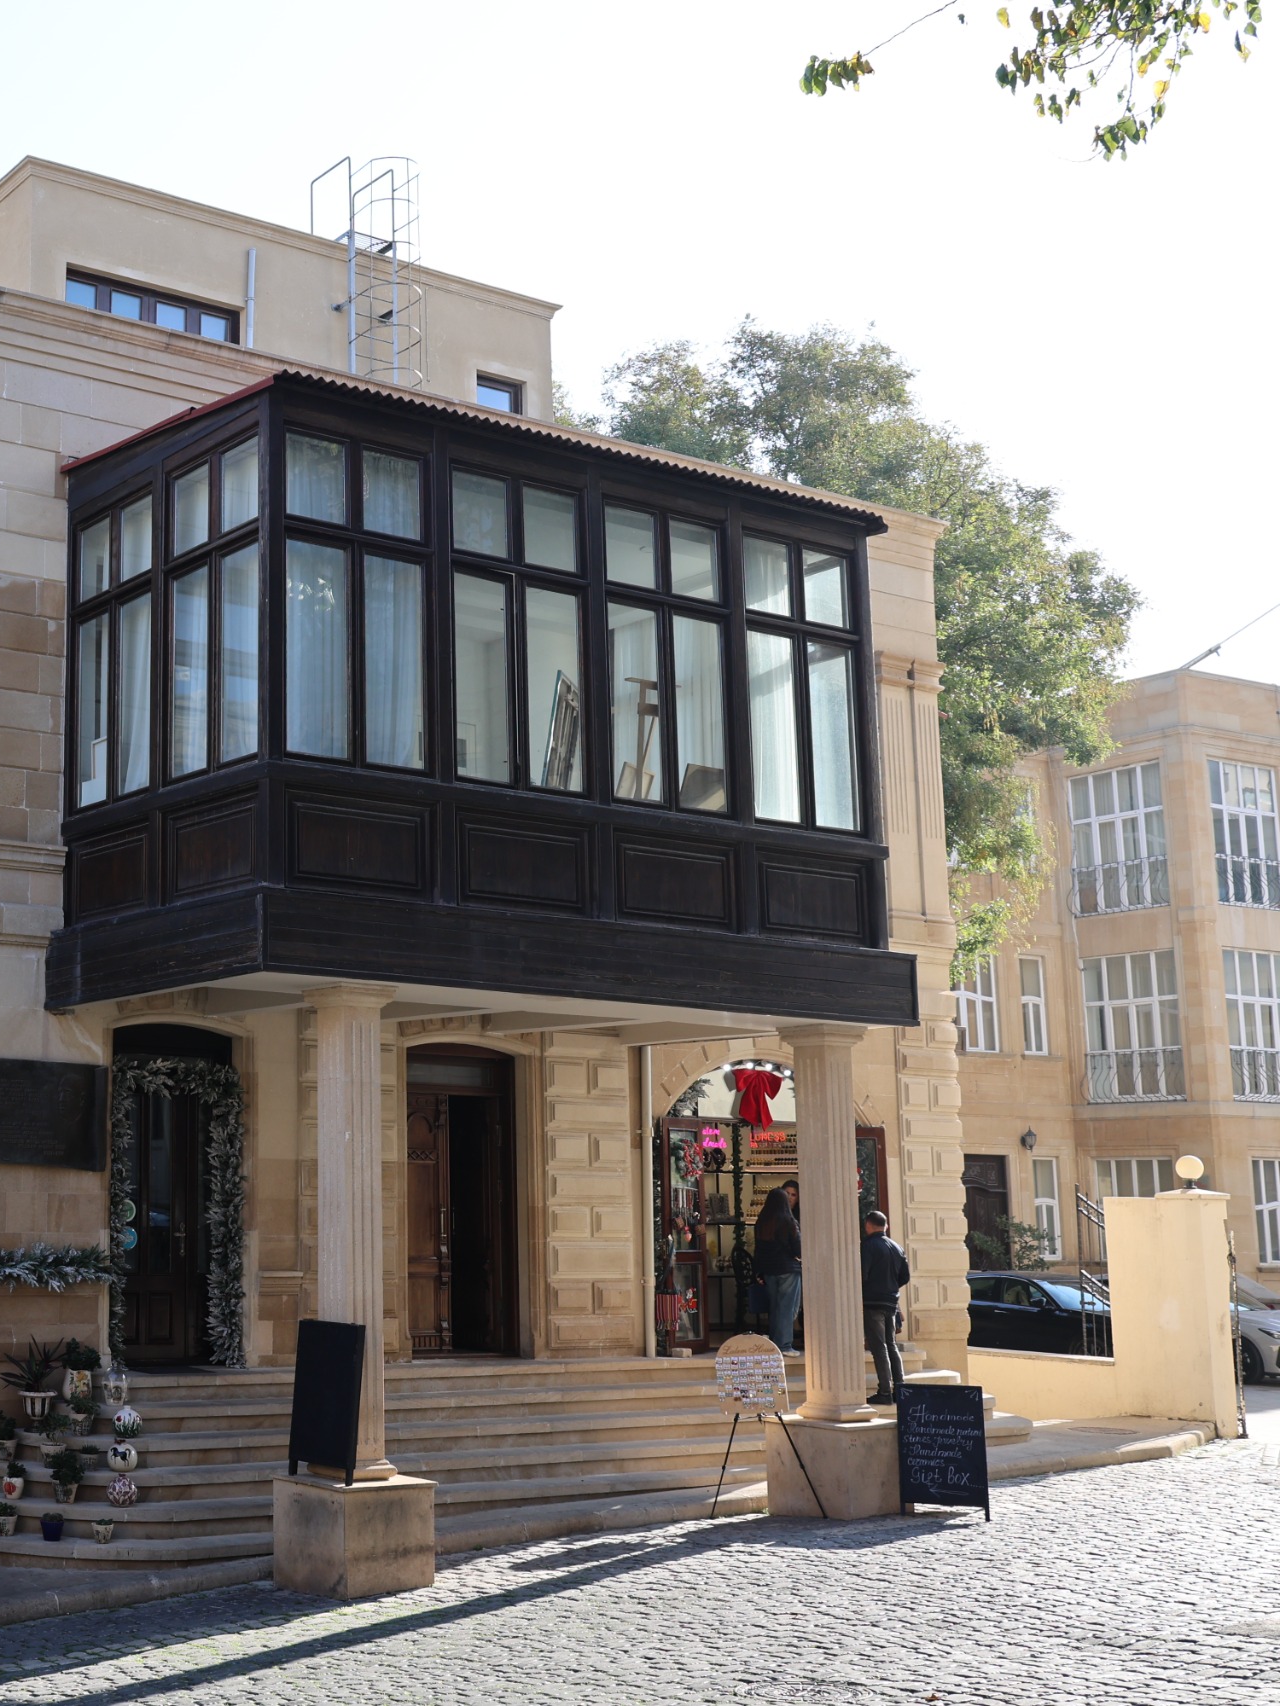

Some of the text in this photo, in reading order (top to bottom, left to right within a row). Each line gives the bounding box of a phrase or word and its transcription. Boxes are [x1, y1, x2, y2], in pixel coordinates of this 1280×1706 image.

[907, 1404, 975, 1423] Handmade
[907, 1422, 955, 1436] Handmade
[908, 1444, 962, 1459] Handmade
